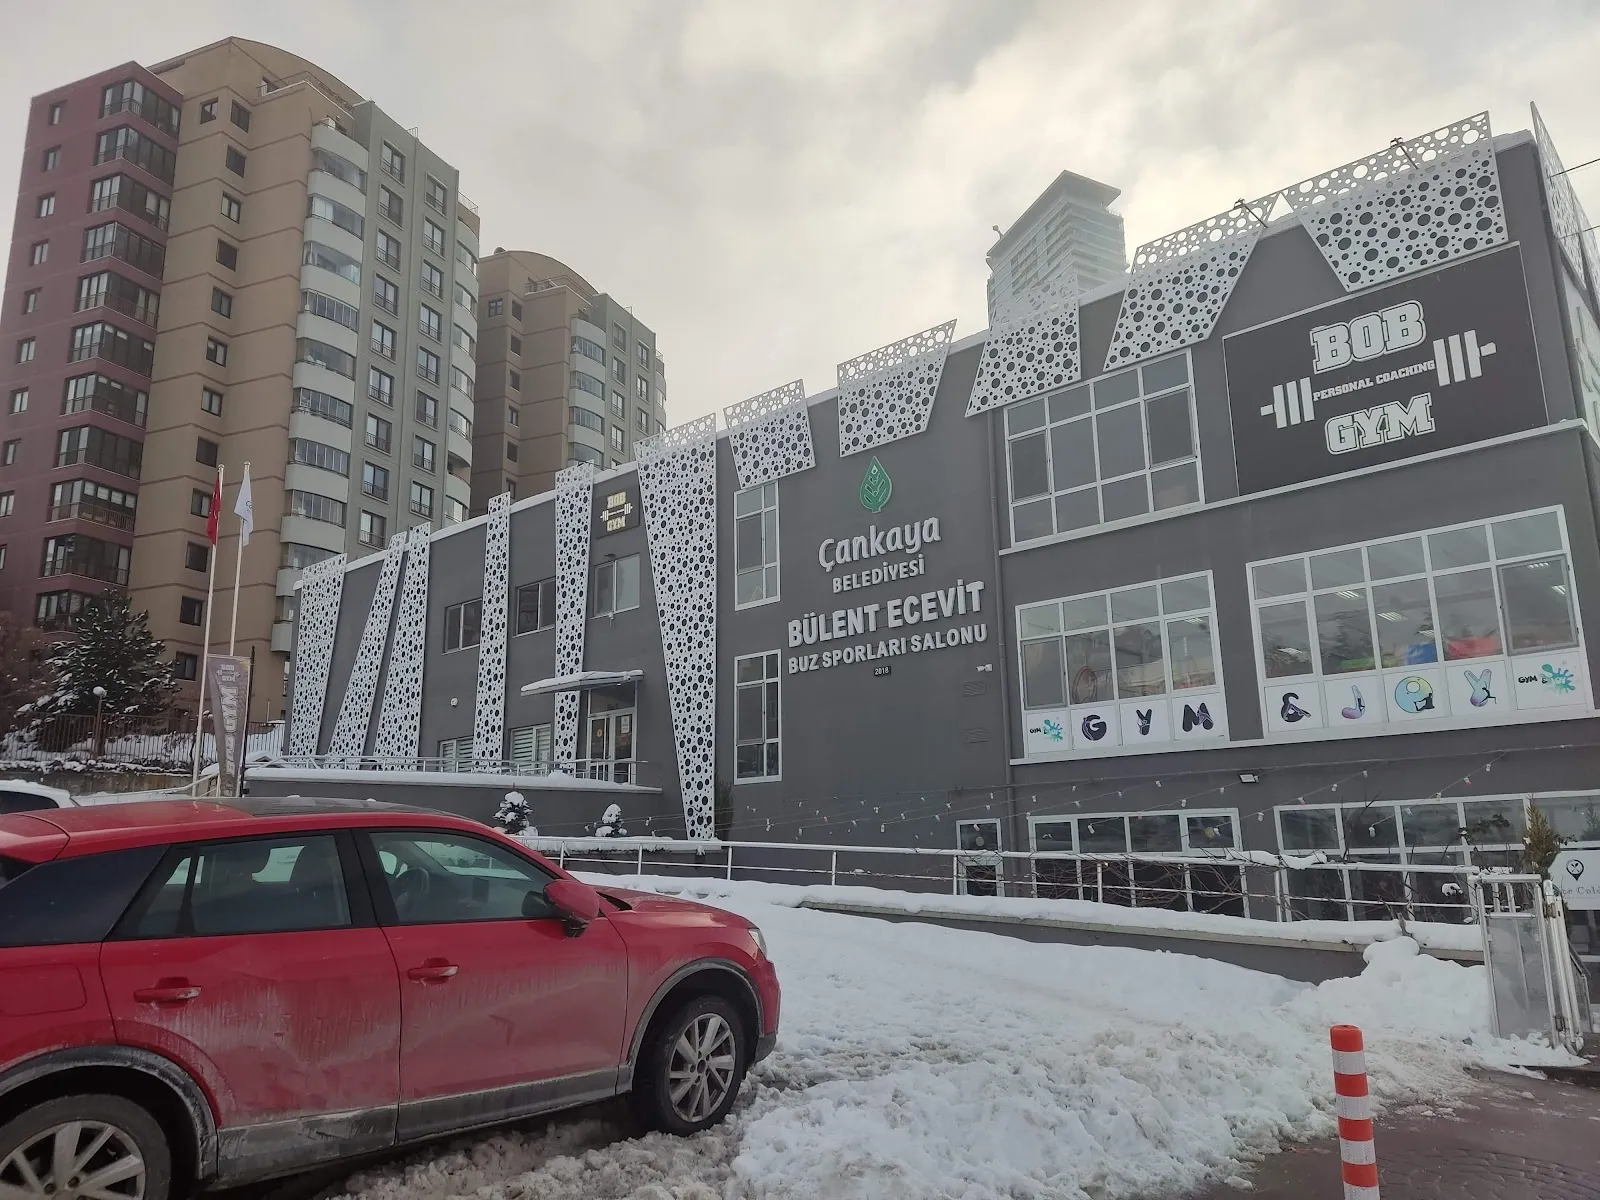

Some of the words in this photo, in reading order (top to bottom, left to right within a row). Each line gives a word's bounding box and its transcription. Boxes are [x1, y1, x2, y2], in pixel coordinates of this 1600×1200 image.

[1309, 299, 1427, 375] BOB
[1312, 377, 1374, 402] PERSONAL
[1375, 359, 1436, 385] COACHING
[1324, 392, 1436, 456] GYM
[607, 491, 626, 509] BOB
[606, 515, 626, 532] GYM
[818, 516, 942, 573] Çankaya
[832, 553, 926, 594] BELEDİYESİ
[787, 602, 880, 649] BÜLENT
[886, 578, 985, 629] ECEVİT
[787, 652, 820, 675] BUZ
[822, 636, 907, 669] SPORLARI
[910, 623, 988, 653] SALONU
[874, 666, 889, 675] 2018
[1517, 675, 1538, 684] GYM
[220, 686, 239, 733] GYM
